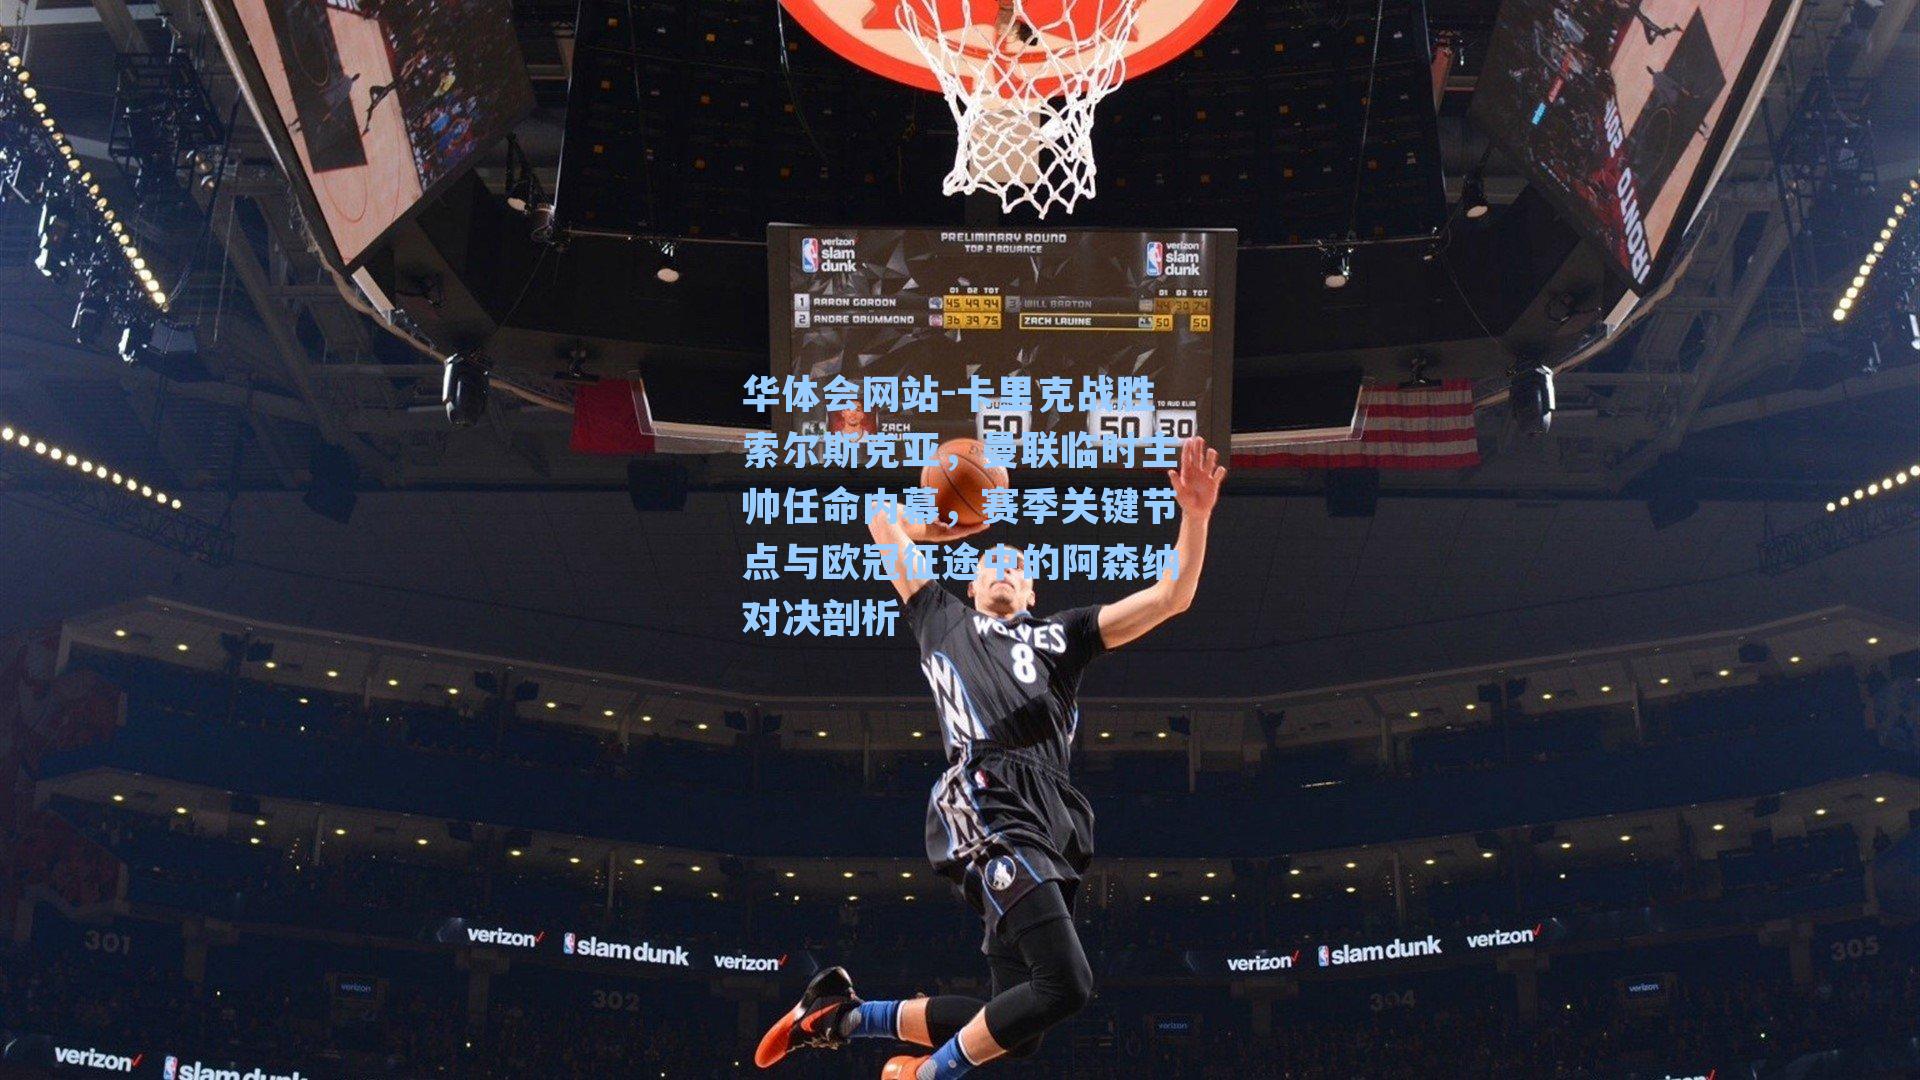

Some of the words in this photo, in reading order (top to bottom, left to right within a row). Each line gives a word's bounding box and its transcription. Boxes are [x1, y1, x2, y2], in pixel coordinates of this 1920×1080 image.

[820, 237, 855, 246] verizon
[940, 232, 1022, 242] PRELIMINARY
[1025, 233, 1067, 243] ROUND
[1165, 241, 1200, 250] verizon
[821, 246, 856, 259] slam
[964, 244, 984, 253] TOP
[986, 245, 993, 253] 2
[995, 245, 1043, 254] ADVANCE
[1165, 250, 1200, 263] slam
[820, 259, 857, 272] dunk
[1164, 263, 1200, 275] dunk
[813, 298, 850, 307] AARON
[853, 298, 897, 307] GORDON
[946, 299, 960, 308] 45
[965, 299, 980, 308] 49
[983, 299, 999, 308] 94
[799, 315, 806, 324] 2
[813, 315, 850, 324] ANDRE
[852, 315, 915, 324] DRUMMOND
[966, 316, 980, 325] 39
[984, 316, 999, 325] 75
[1024, 317, 1052, 326] ZACH
[1055, 317, 1092, 326] LAVINE
[1156, 318, 1170, 327] 50
[1193, 318, 1208, 327] 50
[881, 422, 911, 432] ZACH
[983, 415, 1023, 440] 50
[1101, 416, 1140, 440] 50
[1160, 418, 1193, 438] 30
[973, 614, 1068, 654] WOLVES
[1011, 643, 1037, 684] 8
[83, 929, 132, 955] 301
[467, 926, 536, 949] verizon
[1466, 926, 1534, 949] verizon
[576, 935, 631, 960] slam
[632, 941, 690, 967] dunk
[1331, 942, 1384, 966] slam
[1386, 934, 1443, 960] dunk
[1830, 935, 1880, 962] 305
[713, 952, 779, 972] verizon
[1226, 952, 1292, 972] verizon
[340, 982, 372, 993] verizon
[1628, 982, 1660, 993] verizon
[54, 1046, 132, 1073] verizon
